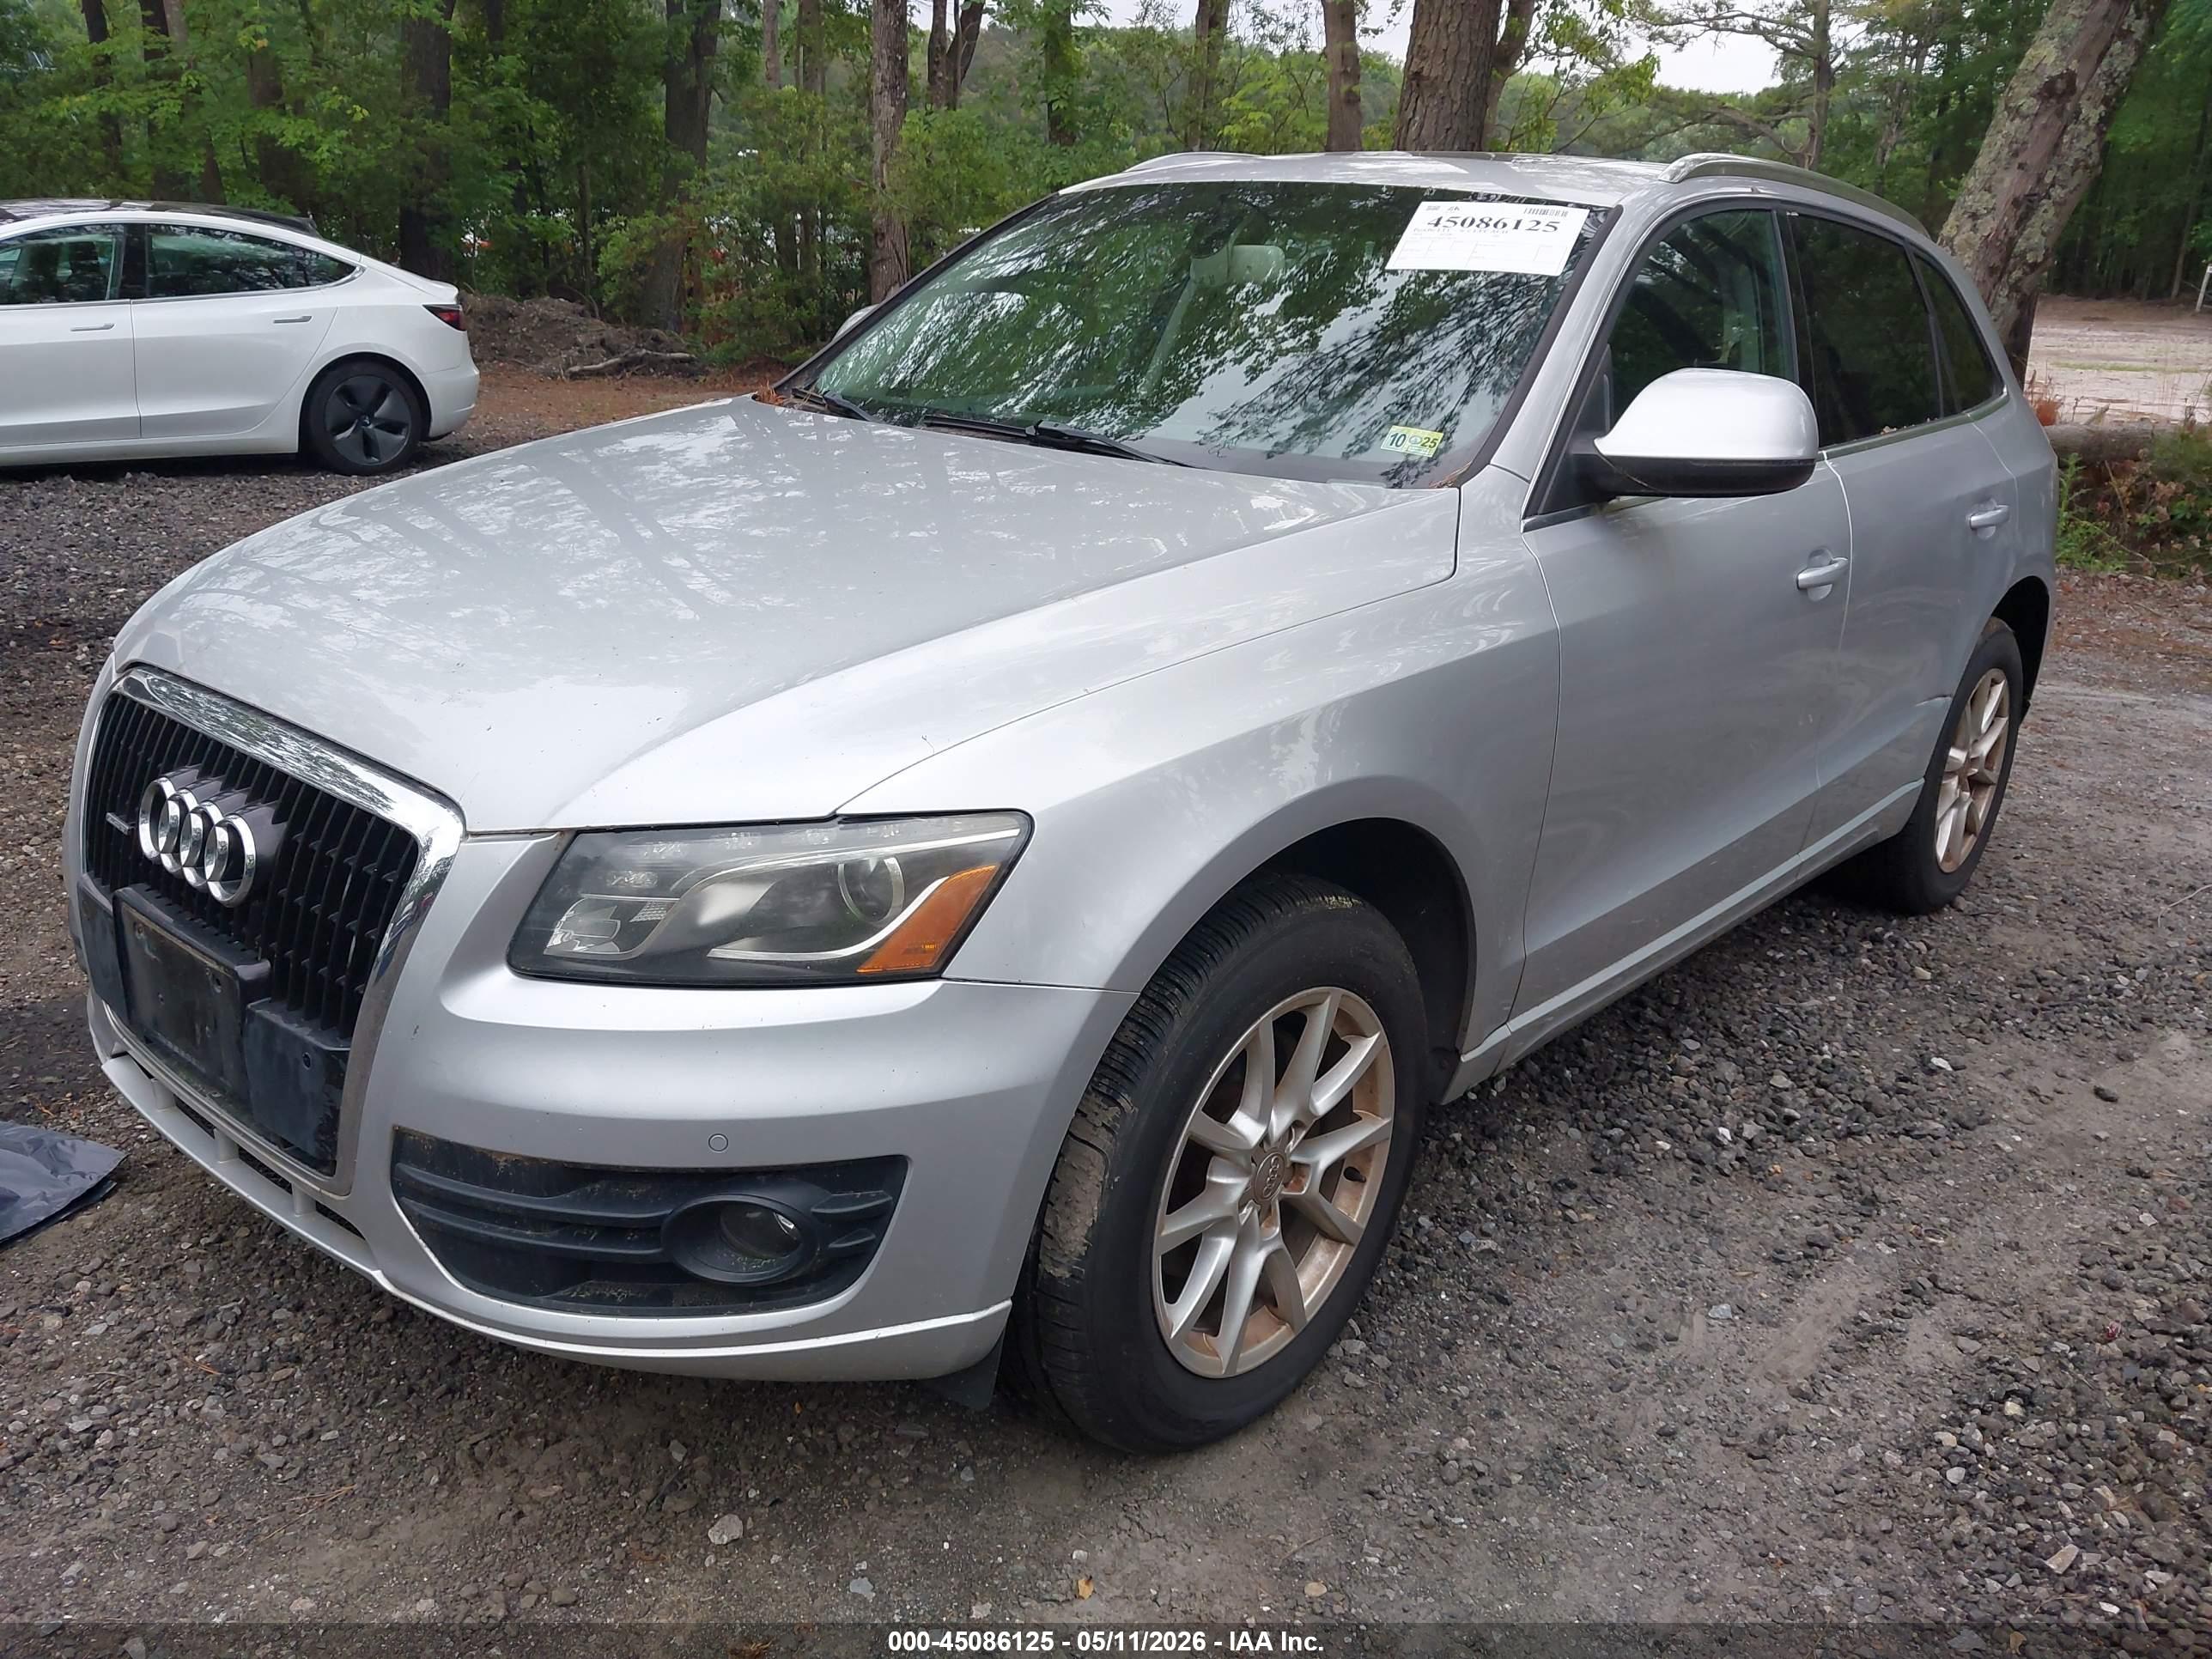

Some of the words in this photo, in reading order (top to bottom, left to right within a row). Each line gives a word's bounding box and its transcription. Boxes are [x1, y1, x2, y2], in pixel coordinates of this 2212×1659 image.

[1427, 216, 1560, 233] 45086125
[1389, 432, 1407, 447] 10
[1420, 436, 1439, 448] 25
